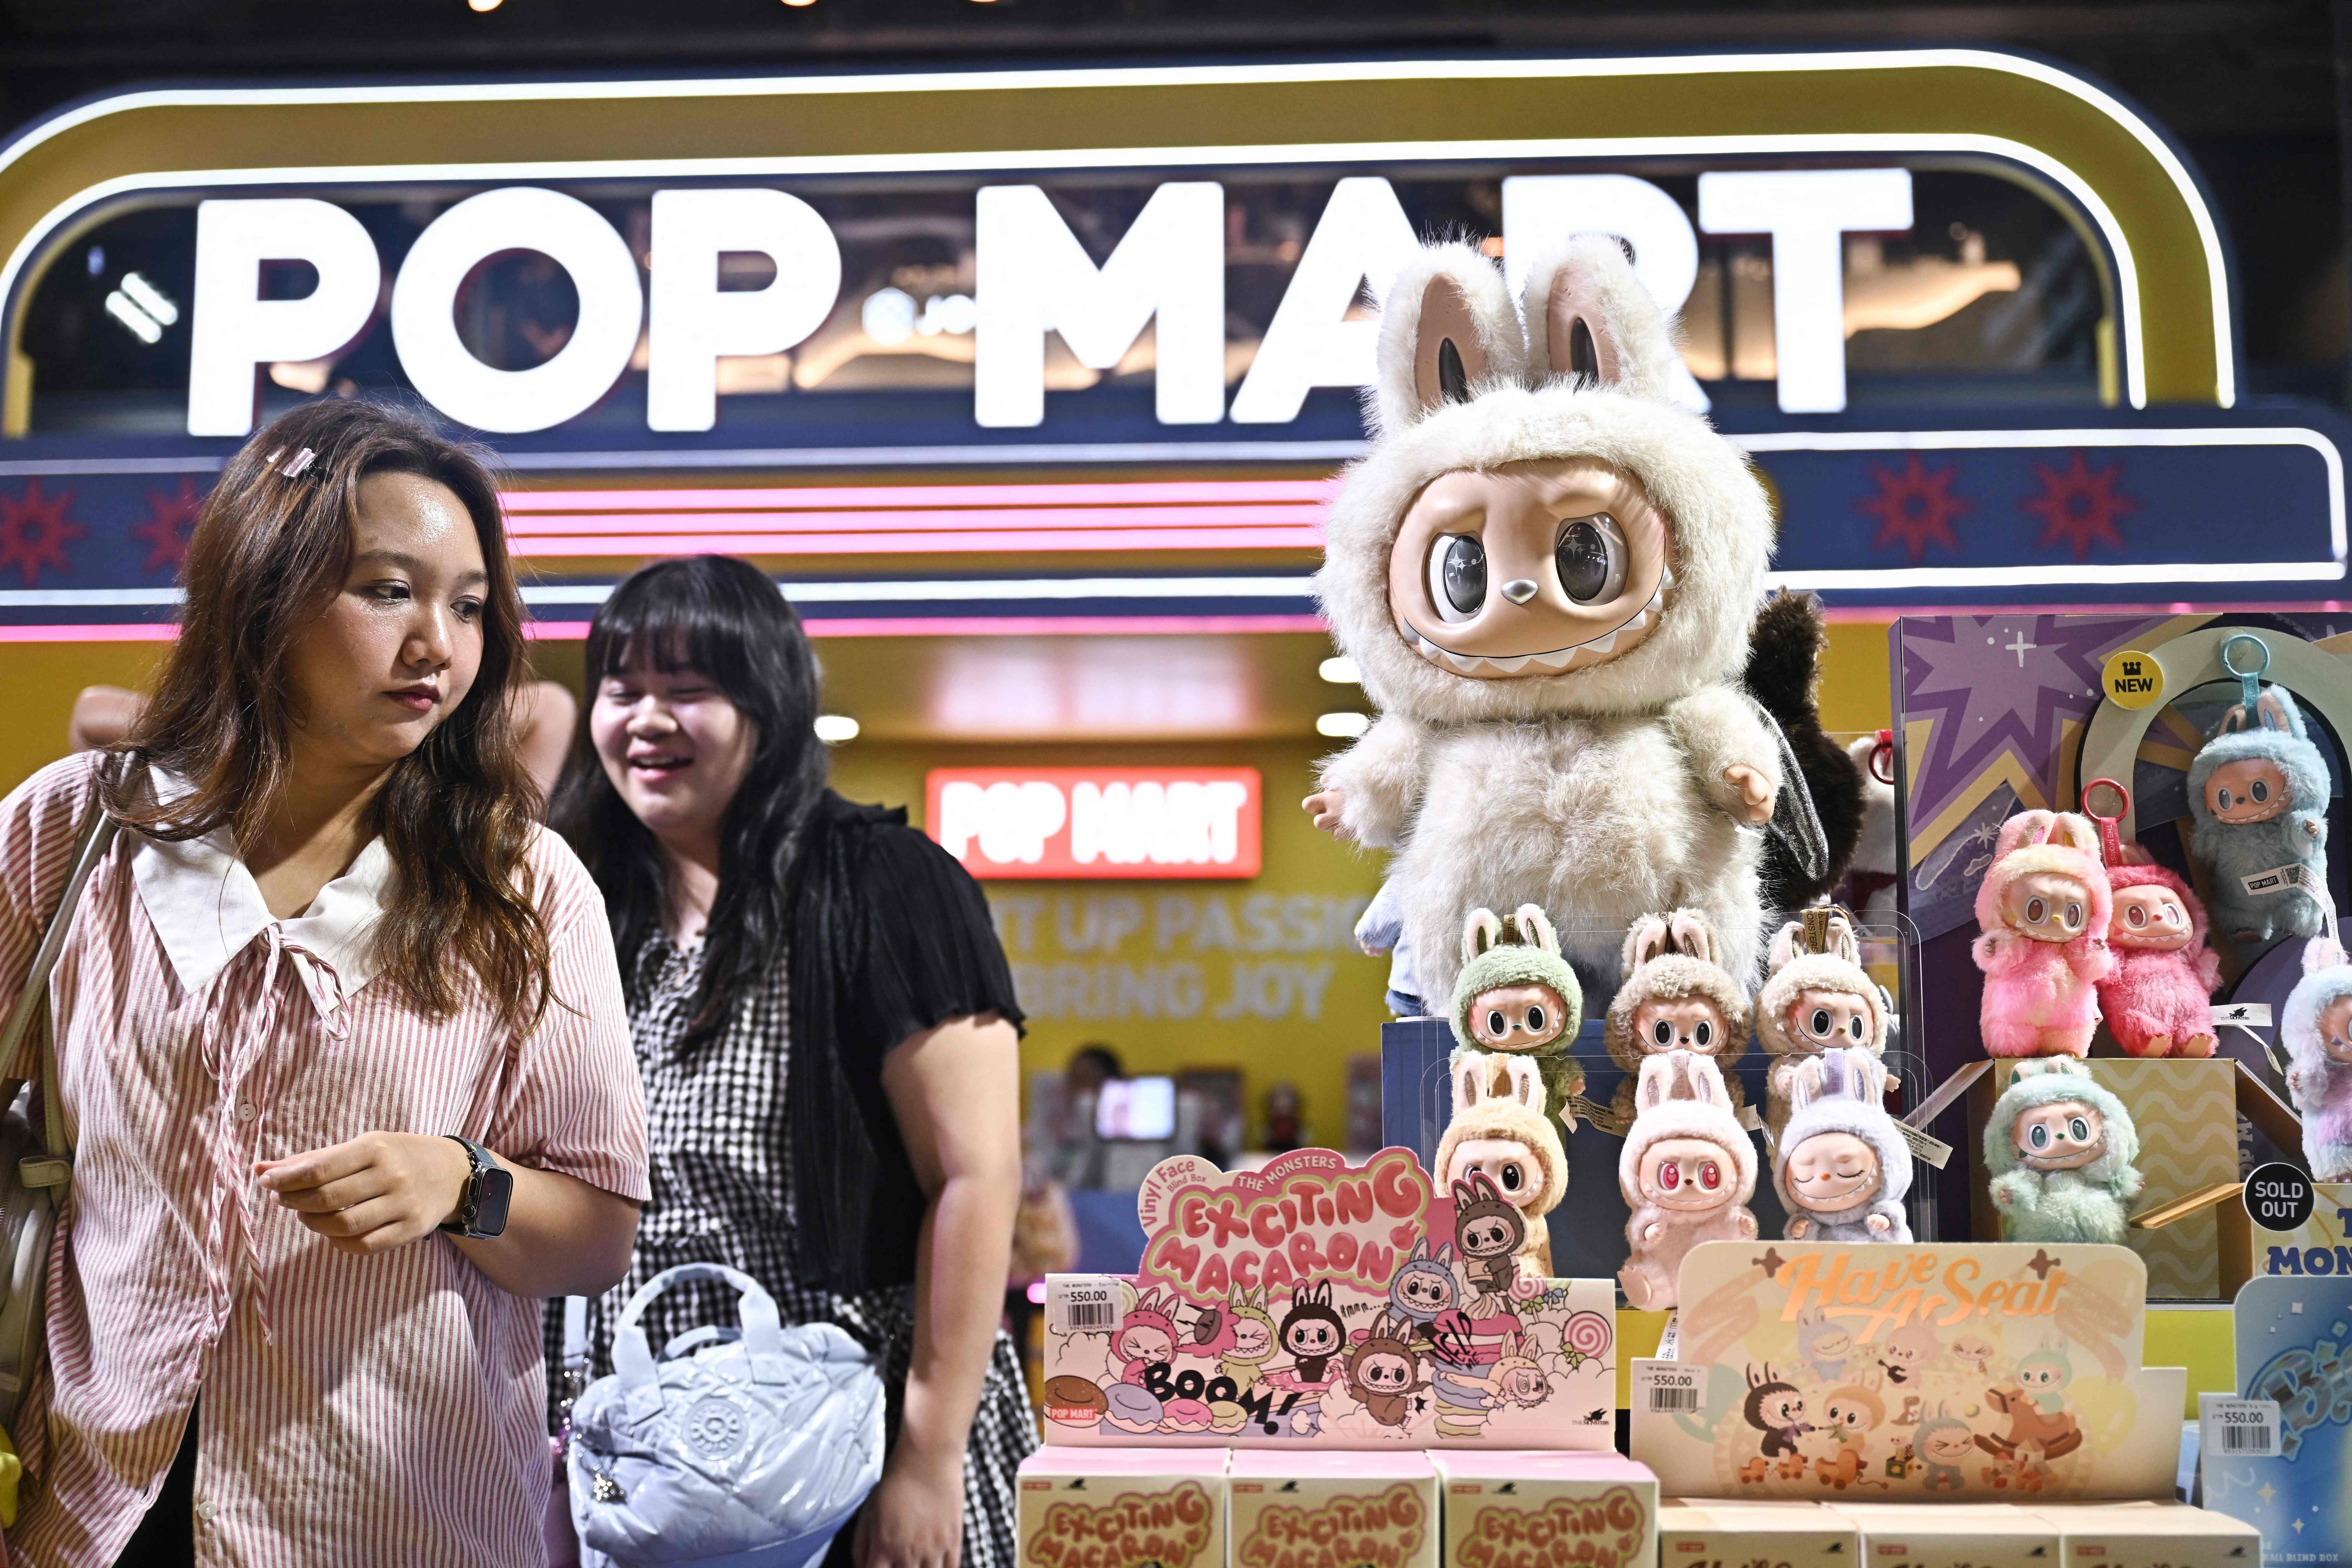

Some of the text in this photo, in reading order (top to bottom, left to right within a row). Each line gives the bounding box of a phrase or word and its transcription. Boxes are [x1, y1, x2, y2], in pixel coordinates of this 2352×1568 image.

[187, 167, 1914, 436] POP MART
[2114, 678, 2153, 693] NEW
[940, 781, 1247, 864] POP MART
[2261, 877, 2277, 887] MART
[1054, 894, 1142, 955] UP
[1009, 960, 1339, 1024] BRING JOY
[1140, 1161, 1195, 1228] Vinyl Face
[1167, 1174, 1207, 1192] Blind Box
[1238, 1156, 1337, 1192] THE MONSTERS
[2255, 1181, 2303, 1199] SOLD
[1182, 1161, 1421, 1248] EXCITING
[2261, 1201, 2298, 1218] OUT
[1154, 1232, 1394, 1294] MACARON
[1071, 1291, 1107, 1302] 550.00
[1775, 1252, 1938, 1322] Have
[1823, 1288, 1945, 1345] A
[1937, 1258, 2067, 1327] Seat
[1144, 1362, 1303, 1435] BOOM!
[1654, 1374, 1692, 1386] 550.00
[1052, 1408, 1094, 1419] POP MART
[2225, 1412, 2263, 1423] 550.00
[1054, 1489, 1204, 1543] EXCITING
[1267, 1491, 1418, 1545] EXCITING
[1484, 1495, 1636, 1548] EXCITING
[1036, 1534, 1187, 1568] MACARON
[1249, 1537, 1400, 1568] MACARON
[2287, 1553, 2316, 1562] BLIND
